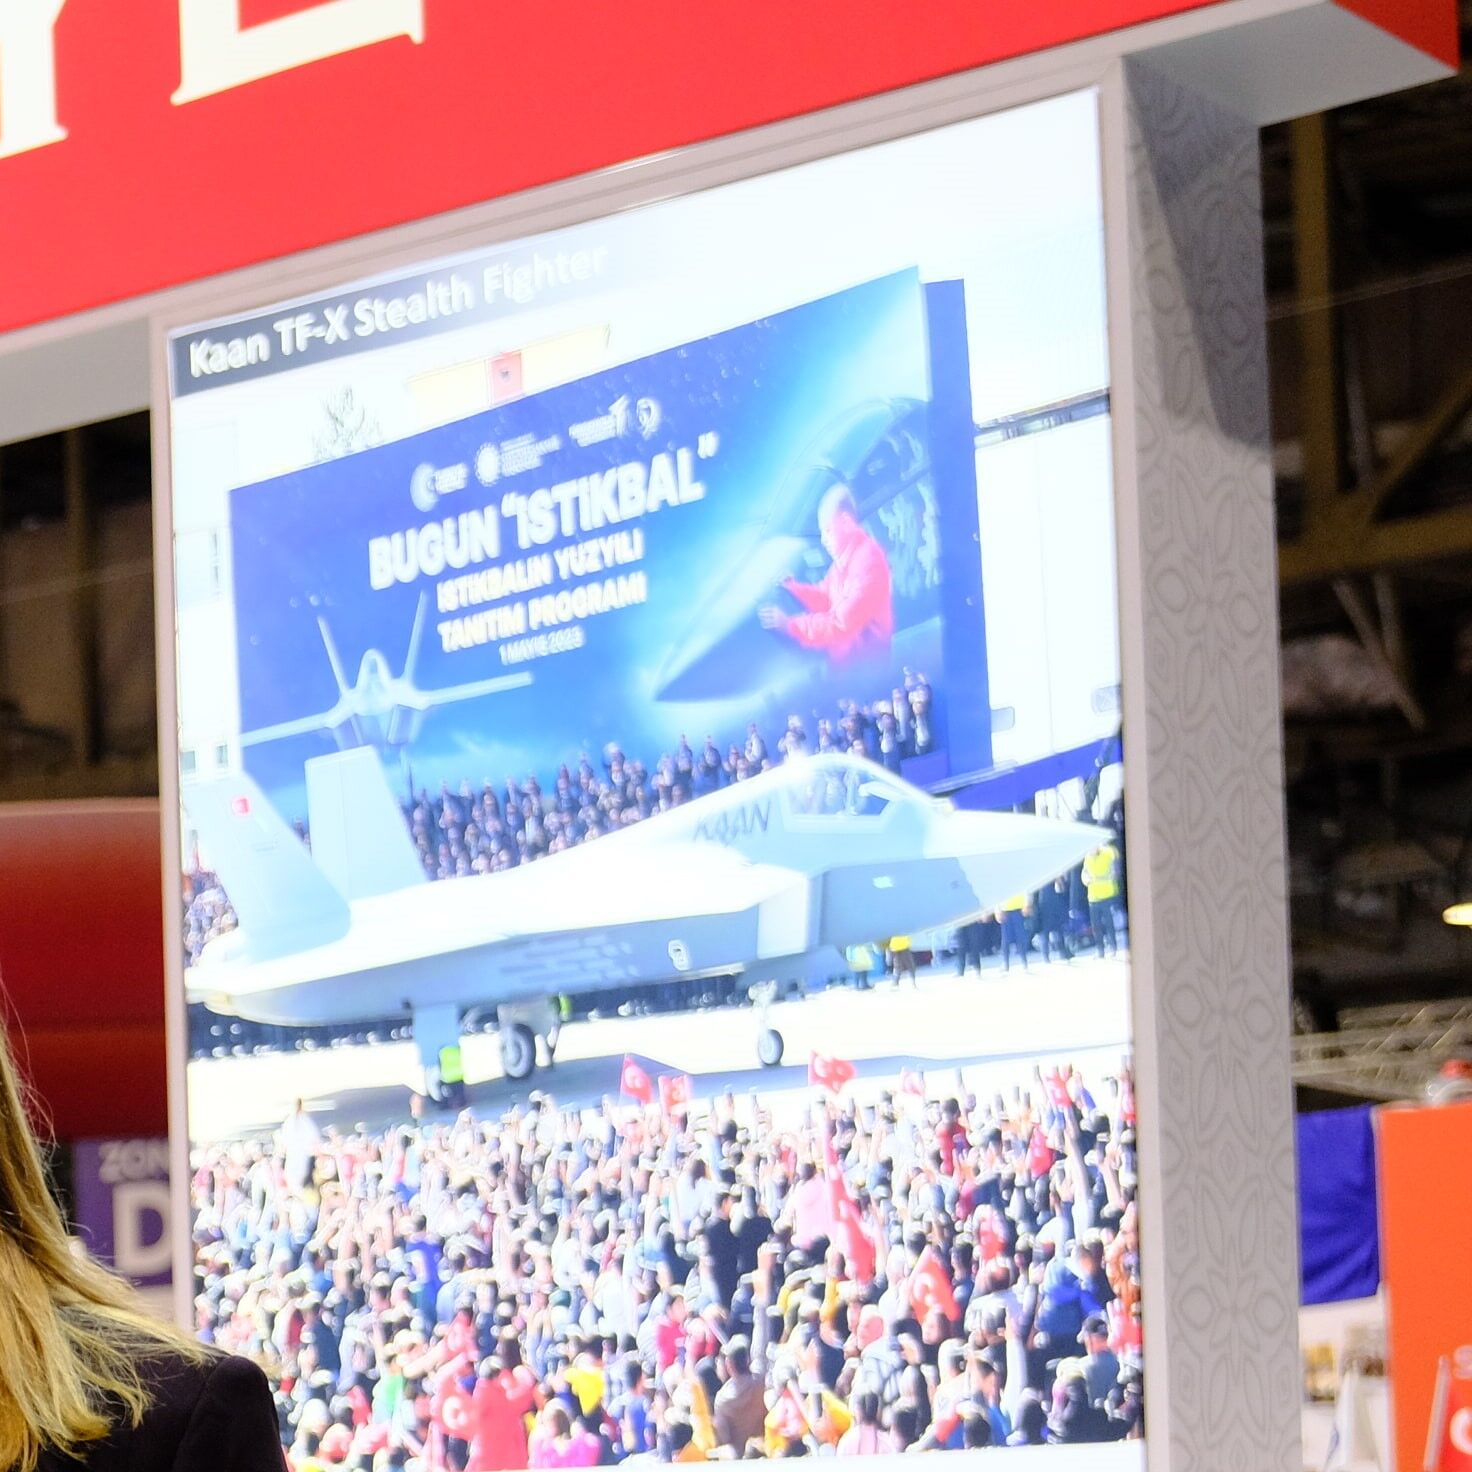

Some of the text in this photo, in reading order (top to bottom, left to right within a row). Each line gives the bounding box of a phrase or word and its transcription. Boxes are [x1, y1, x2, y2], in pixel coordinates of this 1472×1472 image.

[189, 245, 608, 378] Kaan TF-X Stealth Fighter
